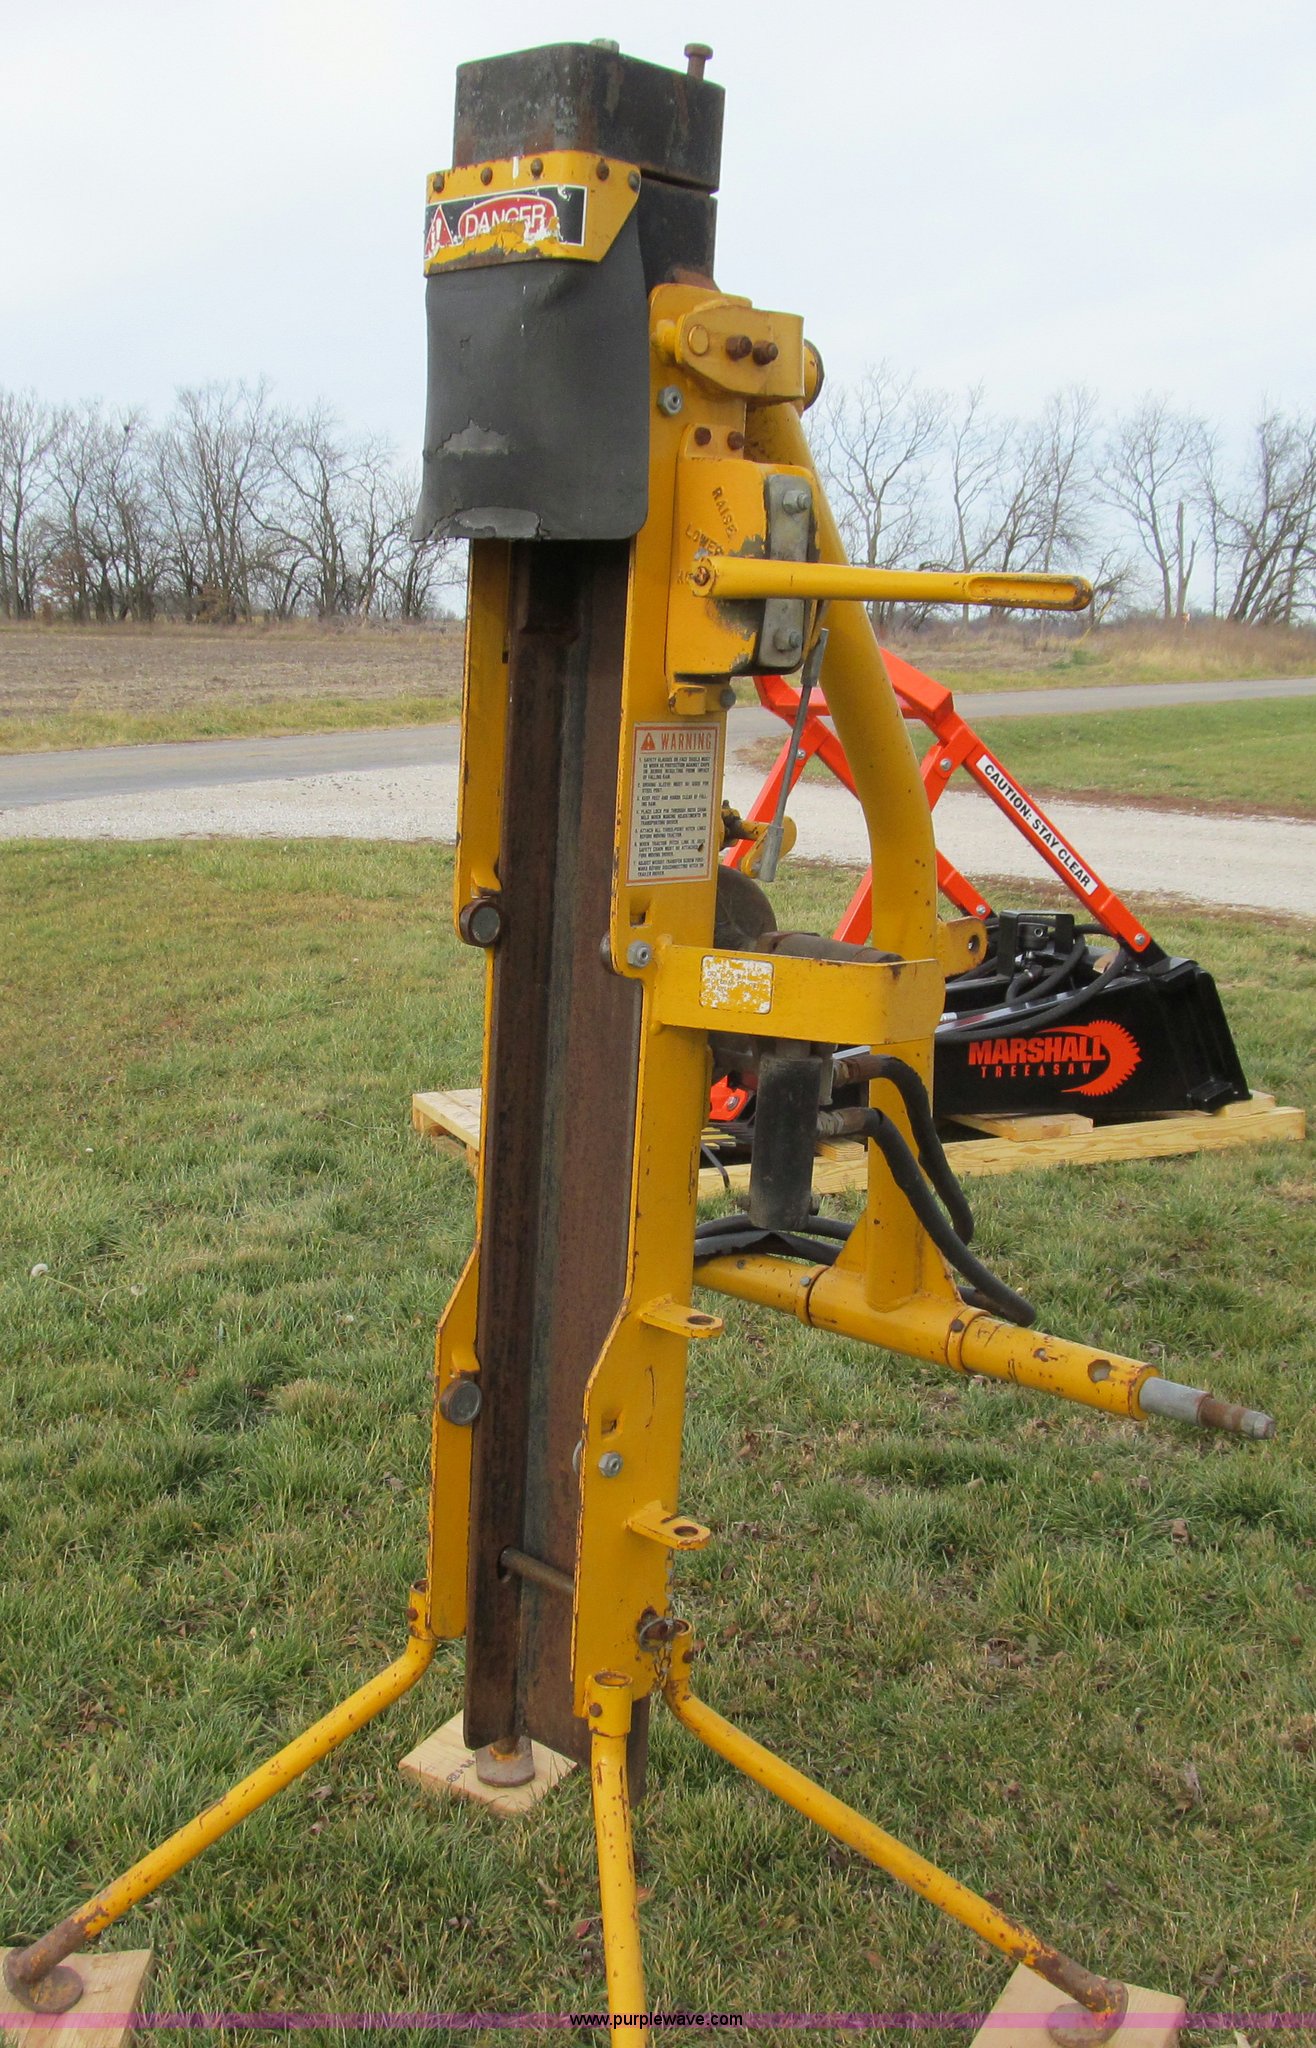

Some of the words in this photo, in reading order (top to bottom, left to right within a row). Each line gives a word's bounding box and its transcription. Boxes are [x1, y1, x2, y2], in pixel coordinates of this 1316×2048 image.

[711, 486, 737, 538] RAISE
[685, 523, 724, 556] LOWER
[661, 733, 711, 751] WARNING
[984, 764, 1032, 820] CAUTION:
[1032, 819, 1060, 849] STAY
[1058, 848, 1091, 887] CLEAR
[968, 1036, 1106, 1065] MARSHALL
[981, 1065, 1030, 1078] TREE
[1053, 1063, 1091, 1075] SAW
